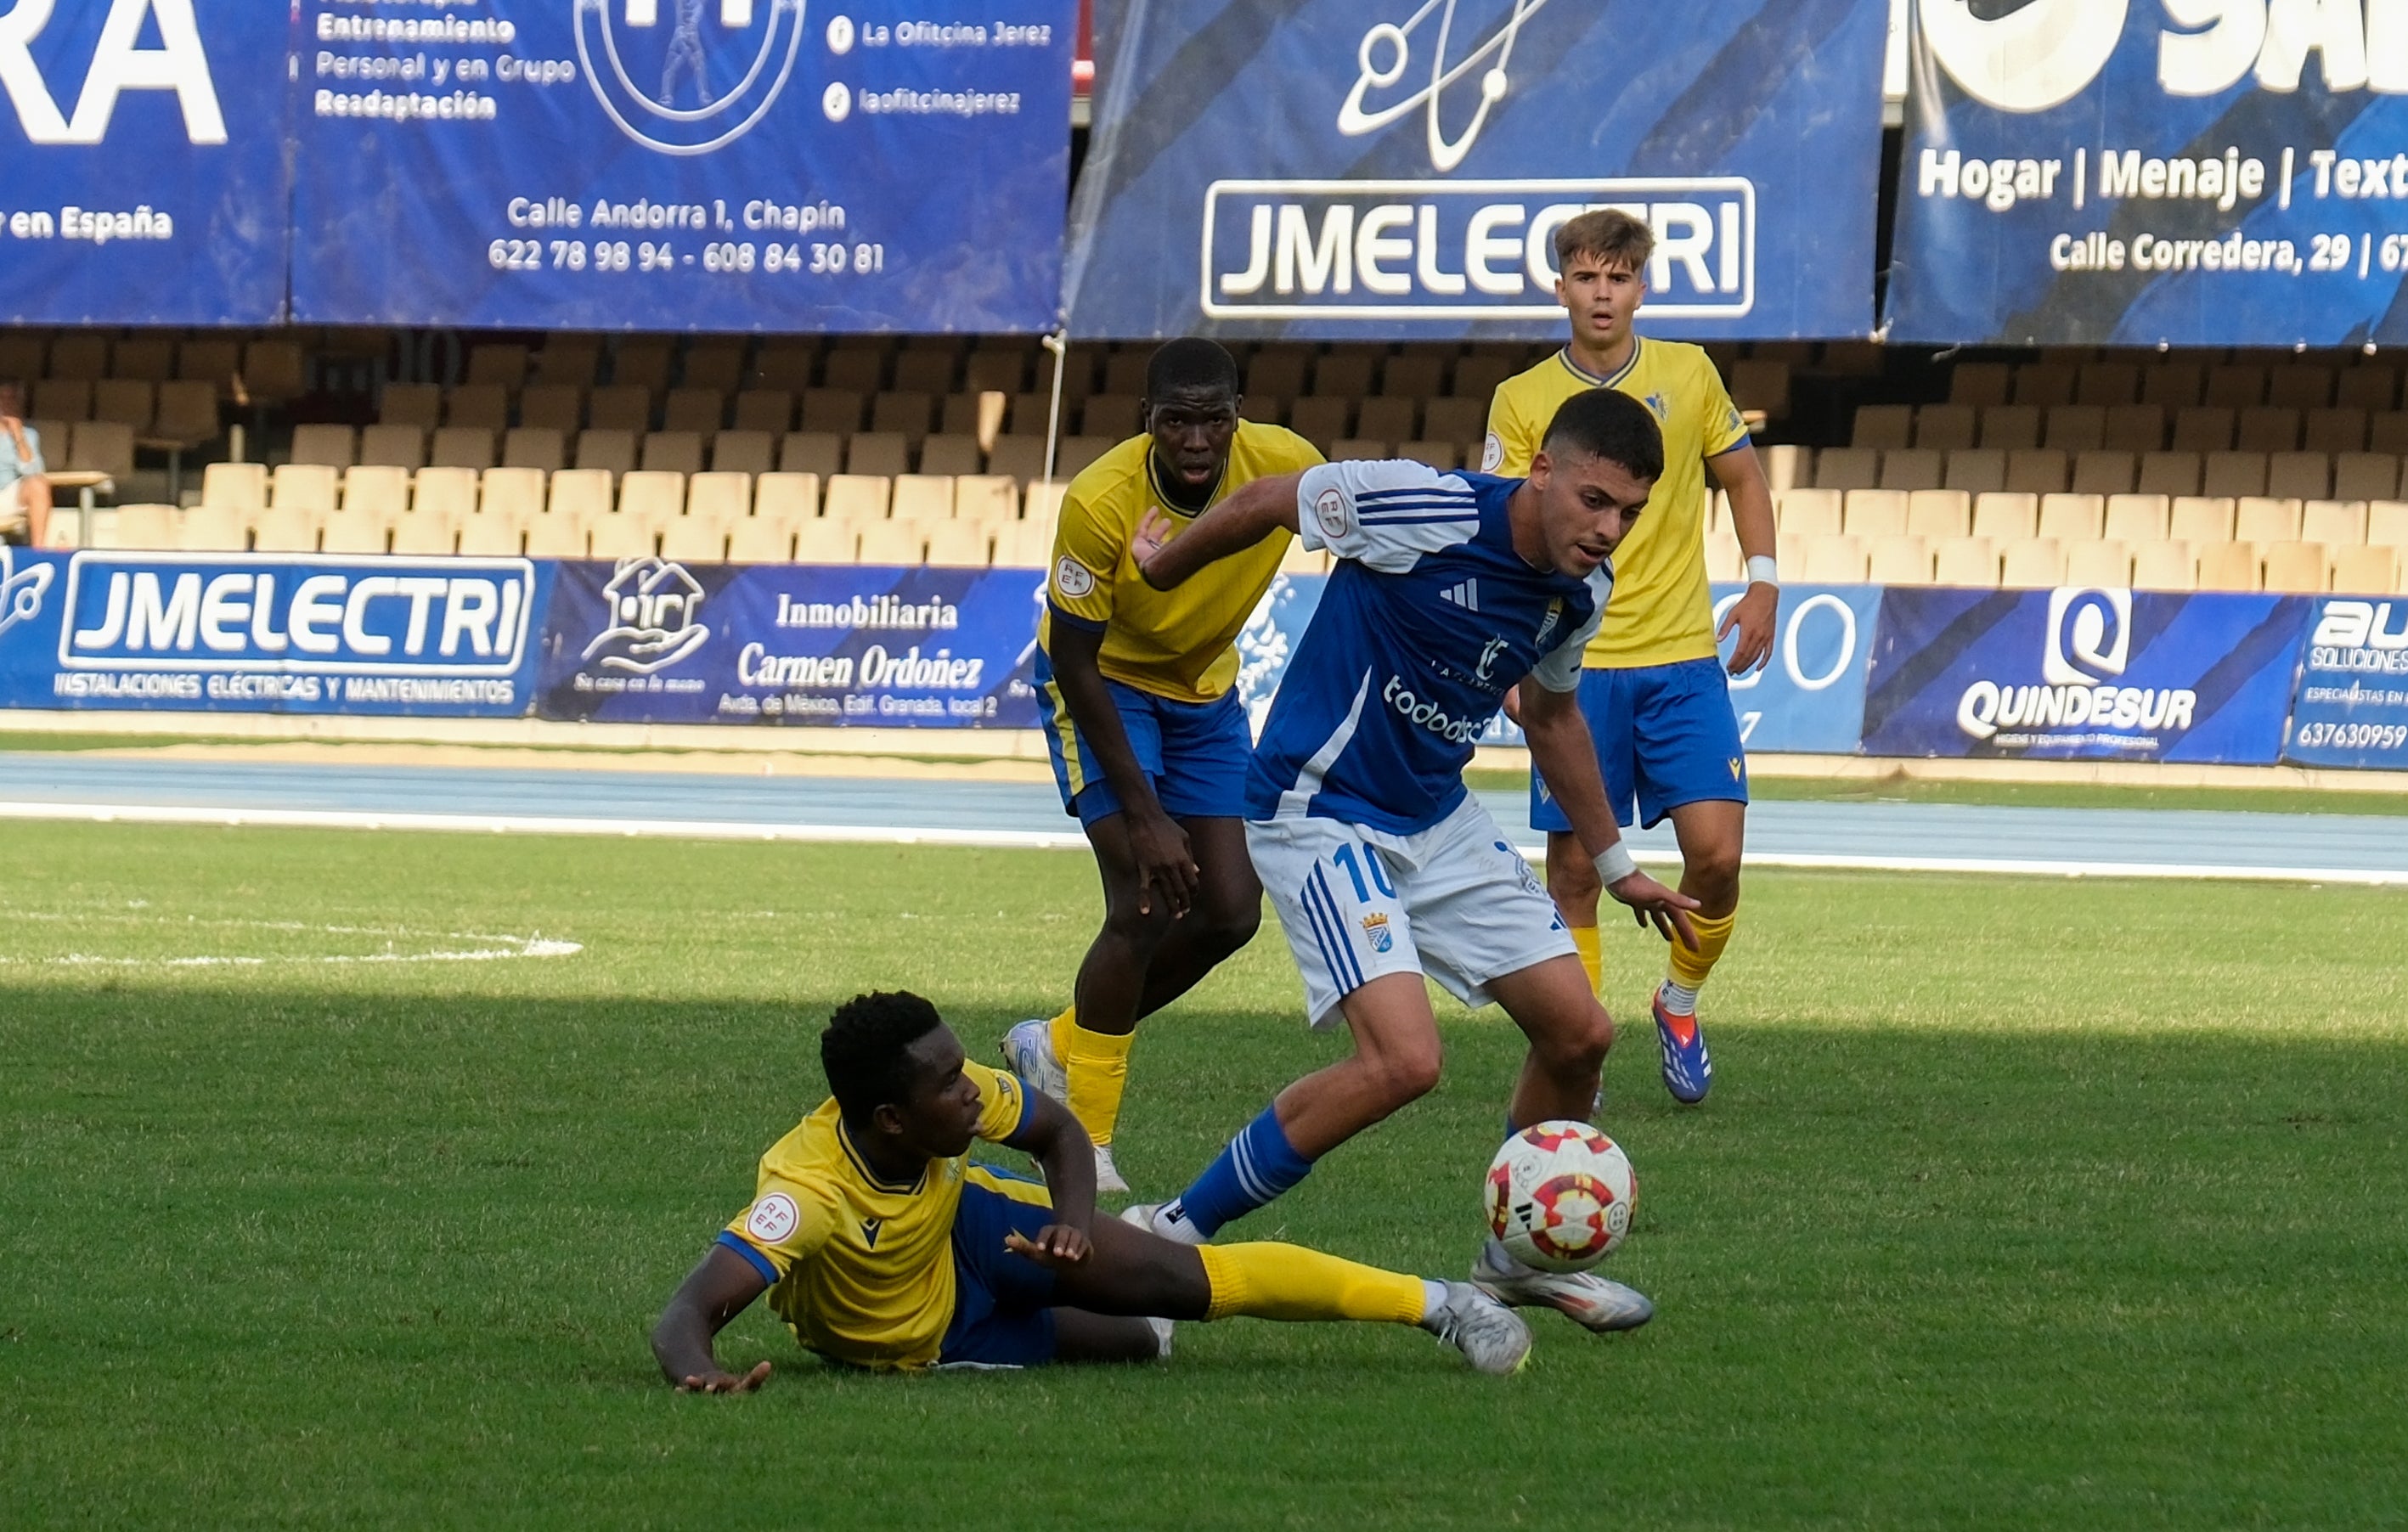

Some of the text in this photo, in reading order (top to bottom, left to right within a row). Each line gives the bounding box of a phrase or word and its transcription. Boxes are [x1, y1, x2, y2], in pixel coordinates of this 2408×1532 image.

[317, 13, 516, 43] Entrenamiento
[862, 21, 889, 46] La
[993, 21, 1051, 46] Jerez
[316, 51, 576, 87] Personal y en Grupo
[314, 89, 497, 121] Readaptación
[1918, 148, 2061, 211] Hogar
[2101, 145, 2265, 211] Menaje
[9, 211, 54, 239] en
[60, 205, 173, 245] España
[508, 196, 583, 228] Calle
[590, 197, 707, 229] Andorra
[713, 199, 734, 234] 1,
[488, 239, 542, 271] 622
[550, 240, 586, 271] 78
[595, 241, 630, 272] 98
[638, 241, 674, 272] 94
[703, 242, 755, 273] 608
[764, 243, 803, 273] 84
[809, 243, 847, 273] 30
[854, 243, 883, 273] 81
[1221, 201, 1740, 296] JMELECRI
[2050, 233, 2125, 271] Calle
[2133, 231, 2303, 277] Corredera,
[2309, 233, 2351, 271] 29
[74, 572, 522, 656] JMELECTRI
[775, 593, 958, 629] Inmobiliaria
[737, 642, 984, 690] Carmen Ordoñez
[54, 671, 515, 704] INSTALACIONES ELÉCTRICAS Y MANTENIMIENTOS
[2305, 686, 2385, 707] ESPECIALISTAS
[985, 696, 997, 718] 2
[1957, 681, 2197, 739] QUINDESUR
[2298, 723, 2407, 749] 637630959
[1333, 842, 1397, 904] 10
